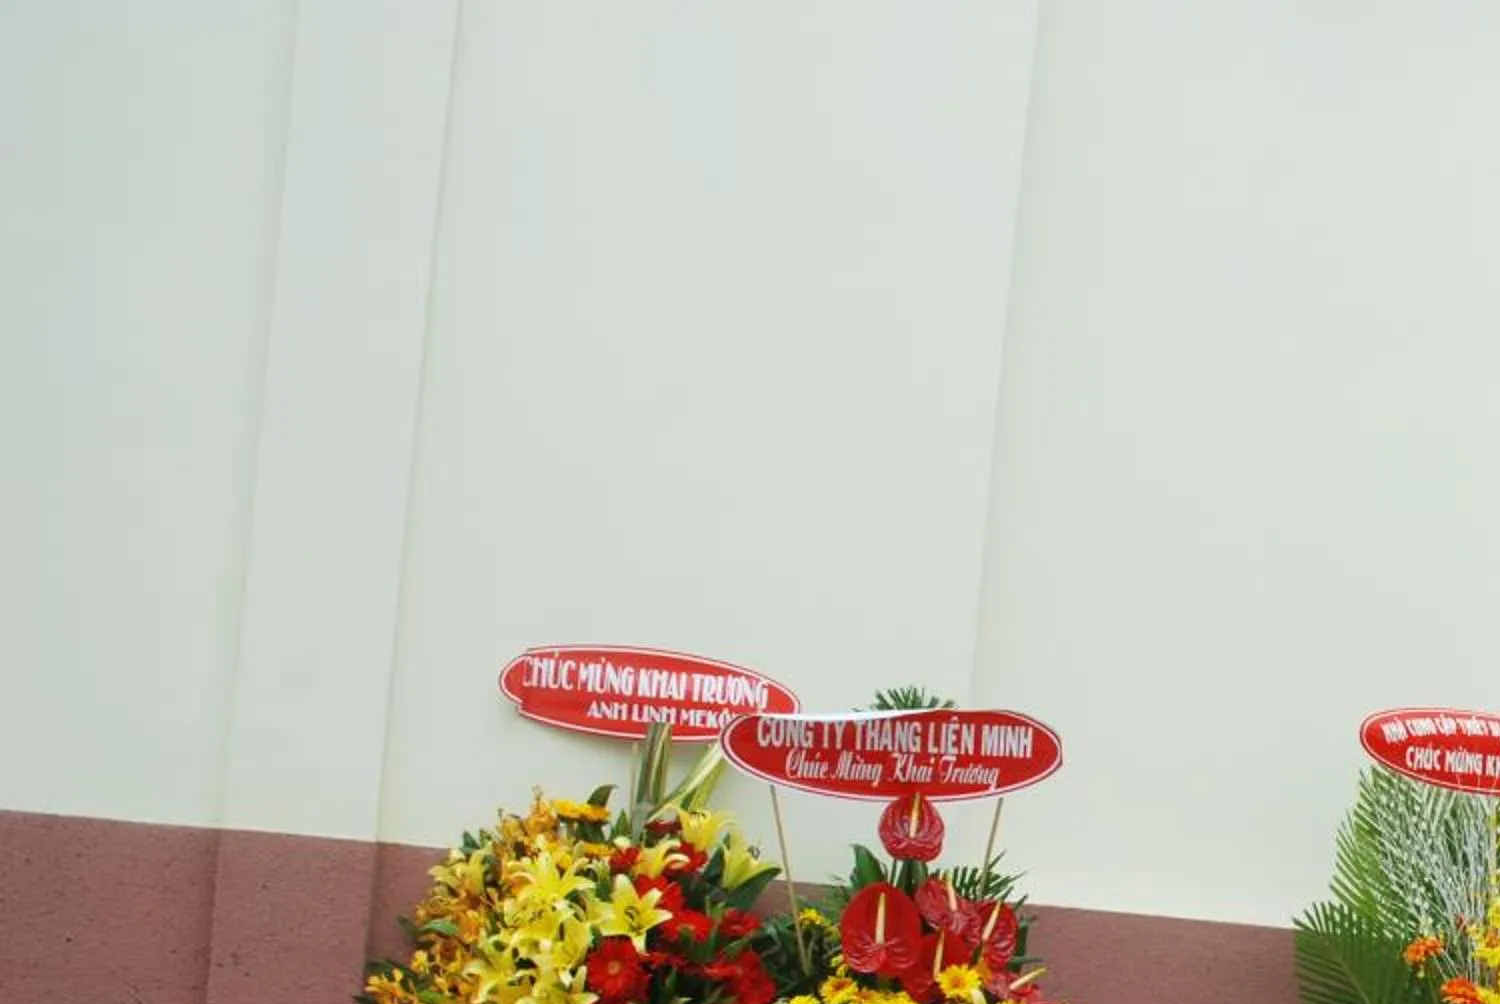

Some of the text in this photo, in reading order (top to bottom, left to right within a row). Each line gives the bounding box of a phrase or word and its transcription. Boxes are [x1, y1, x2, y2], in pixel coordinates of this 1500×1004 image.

[638, 667, 688, 701] KHAI
[586, 700, 628, 721] ANH
[631, 703, 676, 724] LINH
[822, 720, 846, 749] TY
[928, 715, 975, 756] LIÊN
[981, 723, 1033, 759] MINH
[889, 752, 935, 783] Khai
